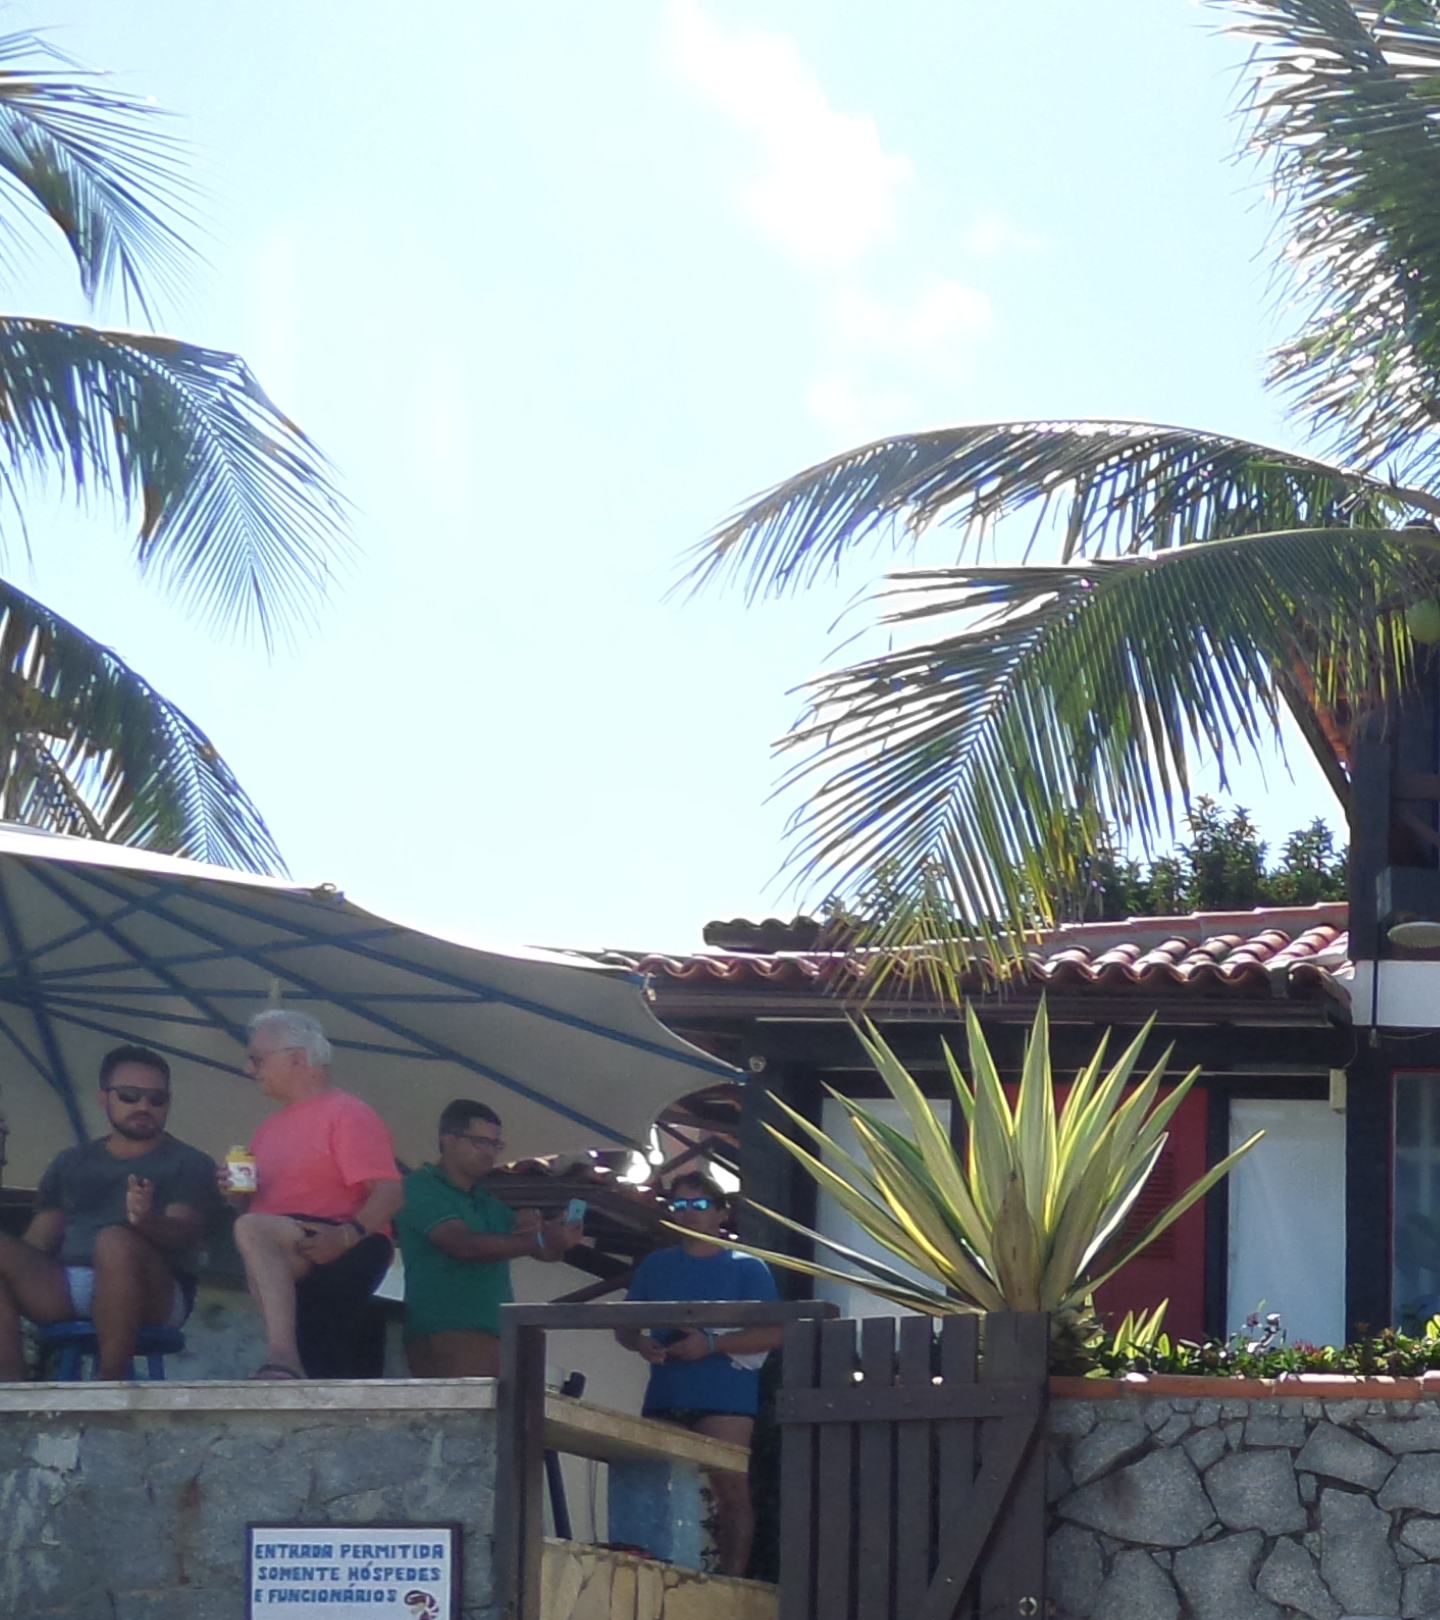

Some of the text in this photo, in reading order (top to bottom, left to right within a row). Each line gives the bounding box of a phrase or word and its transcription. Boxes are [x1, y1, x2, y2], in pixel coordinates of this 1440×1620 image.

[255, 1544, 444, 1559] ENTRADA PERMITIDA
[257, 1561, 442, 1582] SOMENTE HÓSPEDES
[254, 1583, 397, 1603] E FUNCIONÁRIOS
